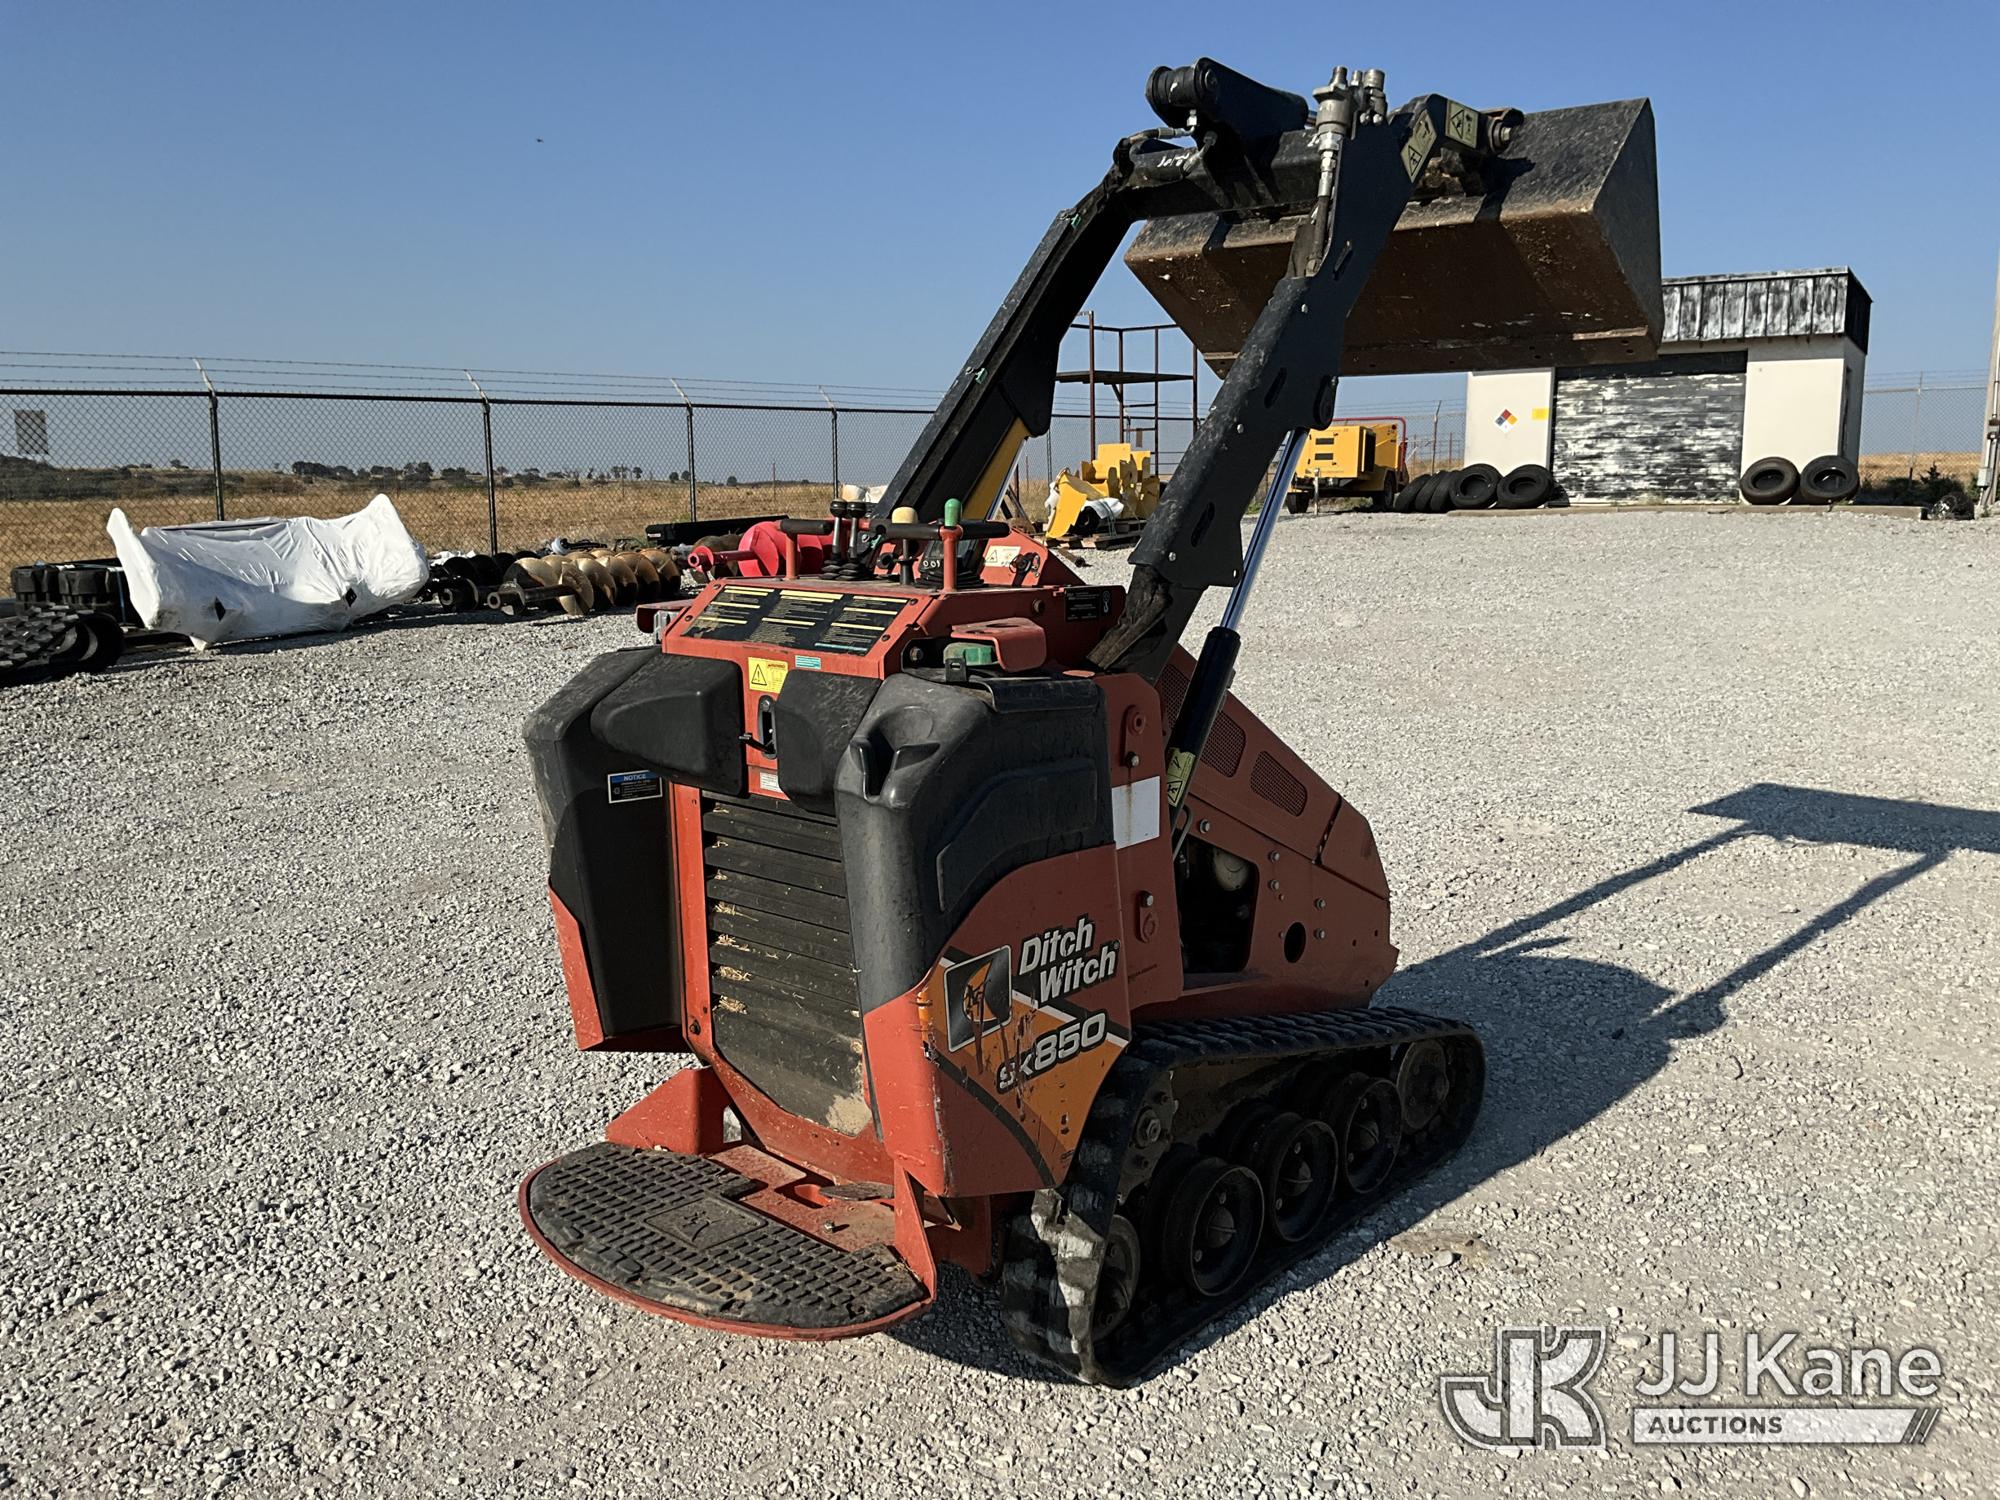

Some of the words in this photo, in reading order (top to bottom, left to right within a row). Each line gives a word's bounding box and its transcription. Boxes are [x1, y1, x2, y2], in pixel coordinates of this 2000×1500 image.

[623, 773, 647, 782] NOTICE
[1018, 917, 1094, 976] Ditch
[1039, 944, 1117, 1004] Witch
